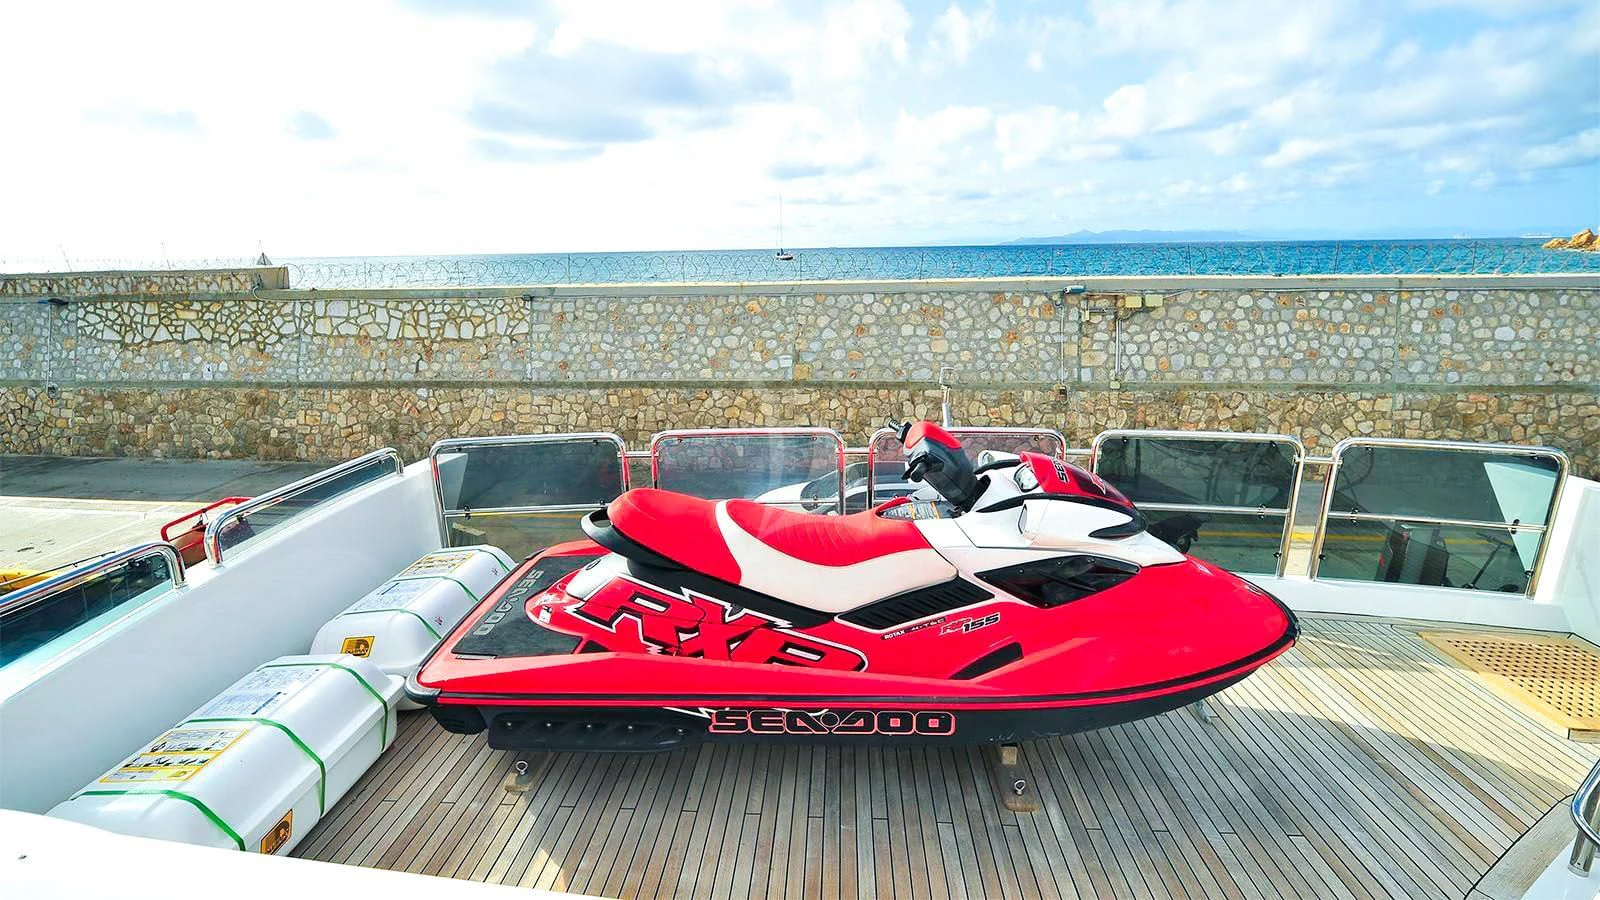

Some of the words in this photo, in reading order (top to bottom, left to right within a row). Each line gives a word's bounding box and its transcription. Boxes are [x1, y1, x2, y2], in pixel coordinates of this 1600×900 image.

[566, 574, 868, 673] RXP
[962, 612, 1001, 634] 155
[884, 629, 906, 640] ROTAX
